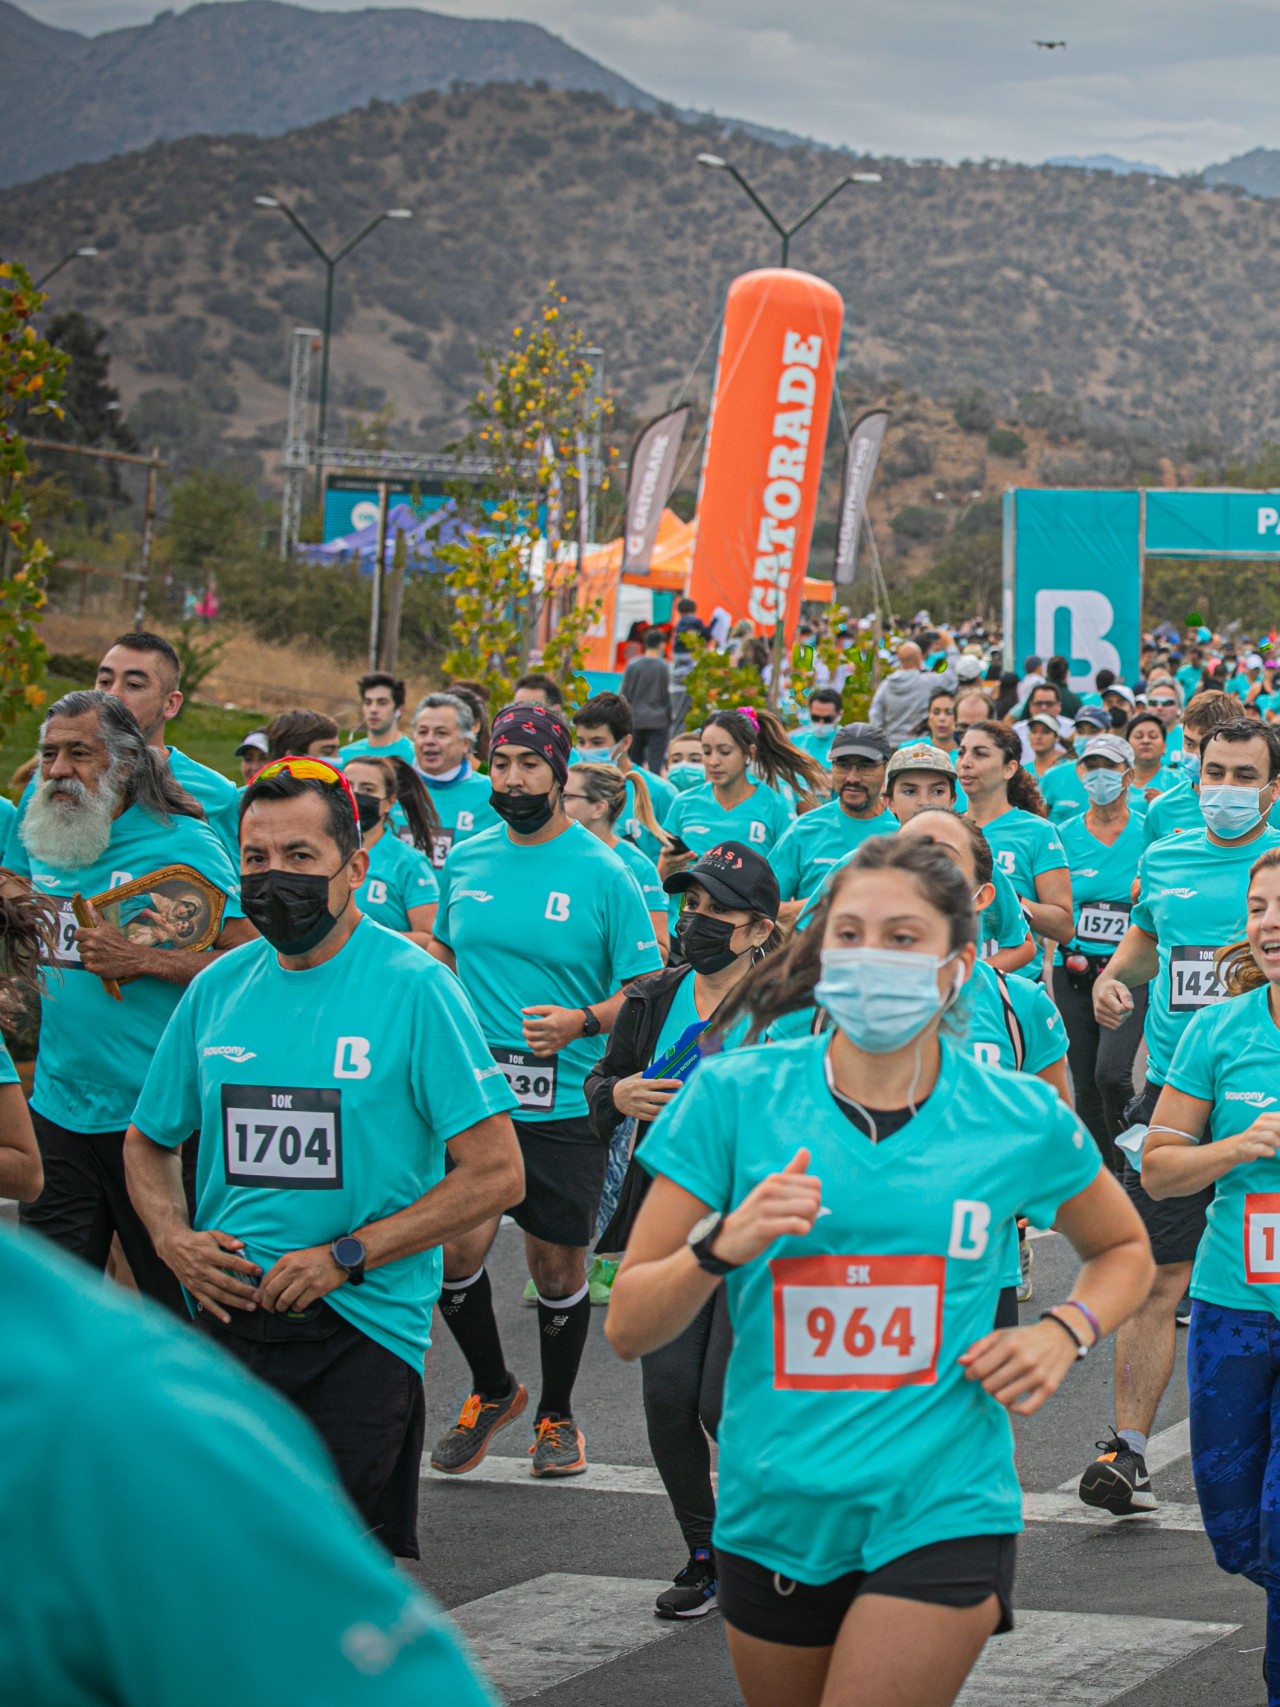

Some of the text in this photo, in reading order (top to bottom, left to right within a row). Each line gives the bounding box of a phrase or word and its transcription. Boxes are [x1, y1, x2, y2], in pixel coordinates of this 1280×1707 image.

[748, 330, 822, 625] GATORADE
[1084, 915, 1125, 936] 1572
[1199, 950, 1215, 960] 10K
[203, 1045, 247, 1057] saucony
[508, 1054, 524, 1065] 10K
[271, 1094, 292, 1109] 10K
[1224, 1091, 1265, 1102] saucony
[235, 1123, 332, 1166] 1704
[846, 1265, 871, 1284] 5K
[806, 1306, 916, 1358] 964
